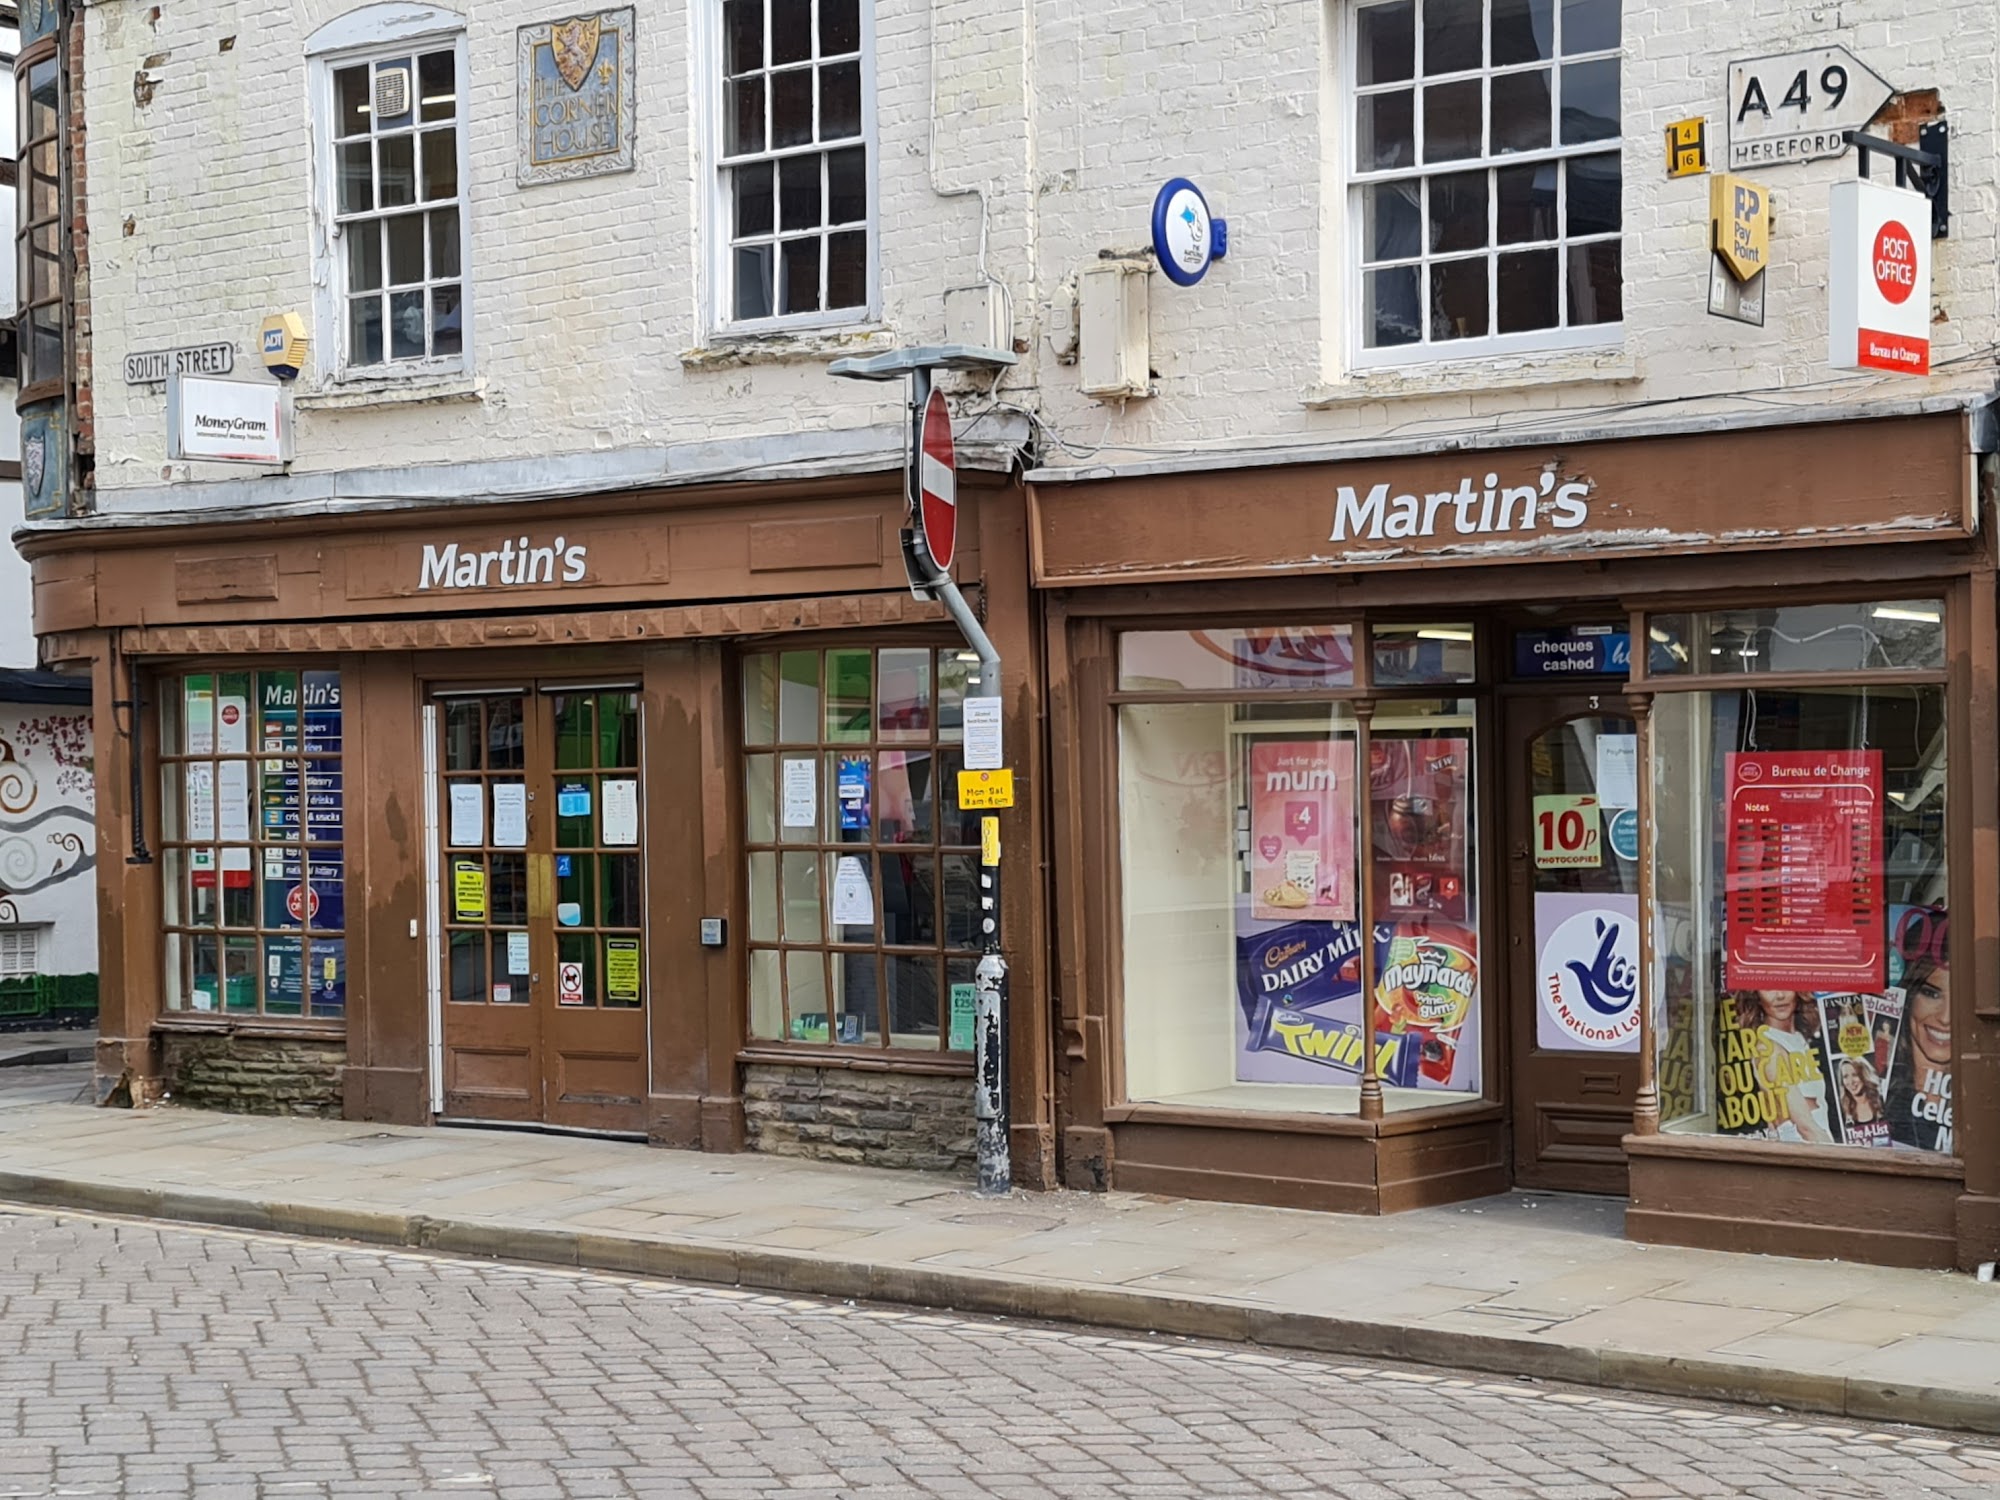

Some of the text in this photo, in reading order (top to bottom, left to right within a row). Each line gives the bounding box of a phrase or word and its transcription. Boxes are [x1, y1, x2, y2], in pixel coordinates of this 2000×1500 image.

[535, 78, 565, 100] THE
[535, 93, 618, 127] CORNER
[541, 122, 611, 155] HOUSE
[1683, 129, 1691, 140] 4
[1736, 134, 1841, 164] HEREFORD
[1682, 153, 1694, 166] 16
[1735, 221, 1751, 245] Pay
[1735, 240, 1759, 263] Point
[1883, 237, 1909, 260] POST
[1876, 259, 1912, 285] OFFICE
[264, 334, 283, 349] ADT
[127, 346, 227, 380] SOUTH STREET
[194, 414, 266, 432] MoneyGram
[1328, 471, 1590, 542] Martin's
[418, 536, 587, 589] Martin's
[1533, 641, 1594, 655] cheques
[1543, 657, 1594, 672] cashed
[265, 683, 340, 706] Matin's
[1589, 696, 1599, 709] 3
[1295, 756, 1308, 767] for
[1430, 757, 1453, 772] NEW
[1771, 764, 1870, 778] Bureau de Change
[1266, 768, 1338, 792] mum
[310, 795, 334, 805] drinks
[1745, 803, 1770, 812] Notes
[1429, 853, 1446, 862] bliss
[1537, 856, 1599, 864] PHOTOCOPIES
[1265, 940, 1308, 968] Cadbury
[1261, 948, 1325, 992] DAIRY
[954, 989, 971, 998] WIN
[1416, 992, 1444, 1006] wine
[1419, 1001, 1457, 1018] gums
[1548, 972, 1562, 1004] The
[1557, 1004, 1621, 1041] National
[1846, 1026, 1862, 1036] NEW
[1758, 1048, 1824, 1089] CARE
[1846, 1128, 1863, 1140] The
